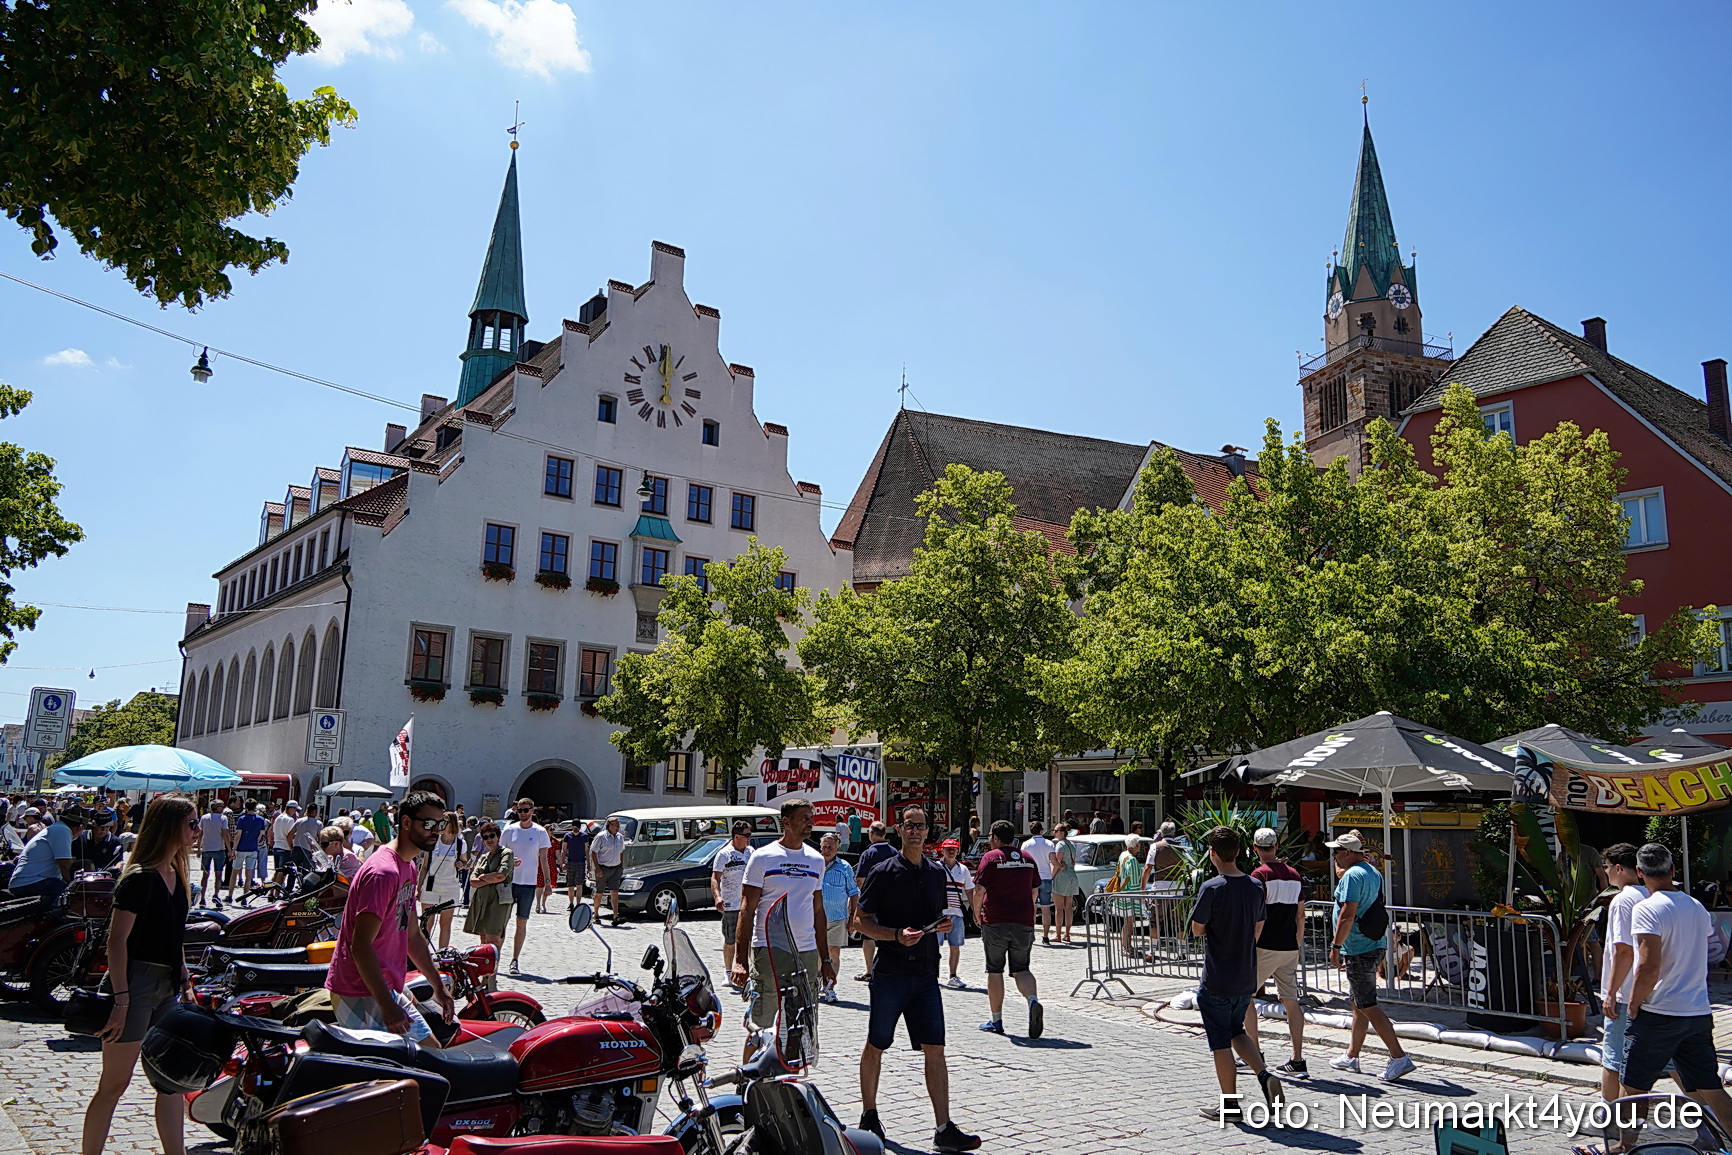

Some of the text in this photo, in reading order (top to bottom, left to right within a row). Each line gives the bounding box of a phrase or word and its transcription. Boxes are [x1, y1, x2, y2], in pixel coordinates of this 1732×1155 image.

[838, 756, 876, 782] LIQUI
[836, 778, 875, 804] MOLY
[1587, 761, 1732, 811] BEACH
[1467, 940, 1488, 1010] now
[600, 1039, 648, 1049] HONDA
